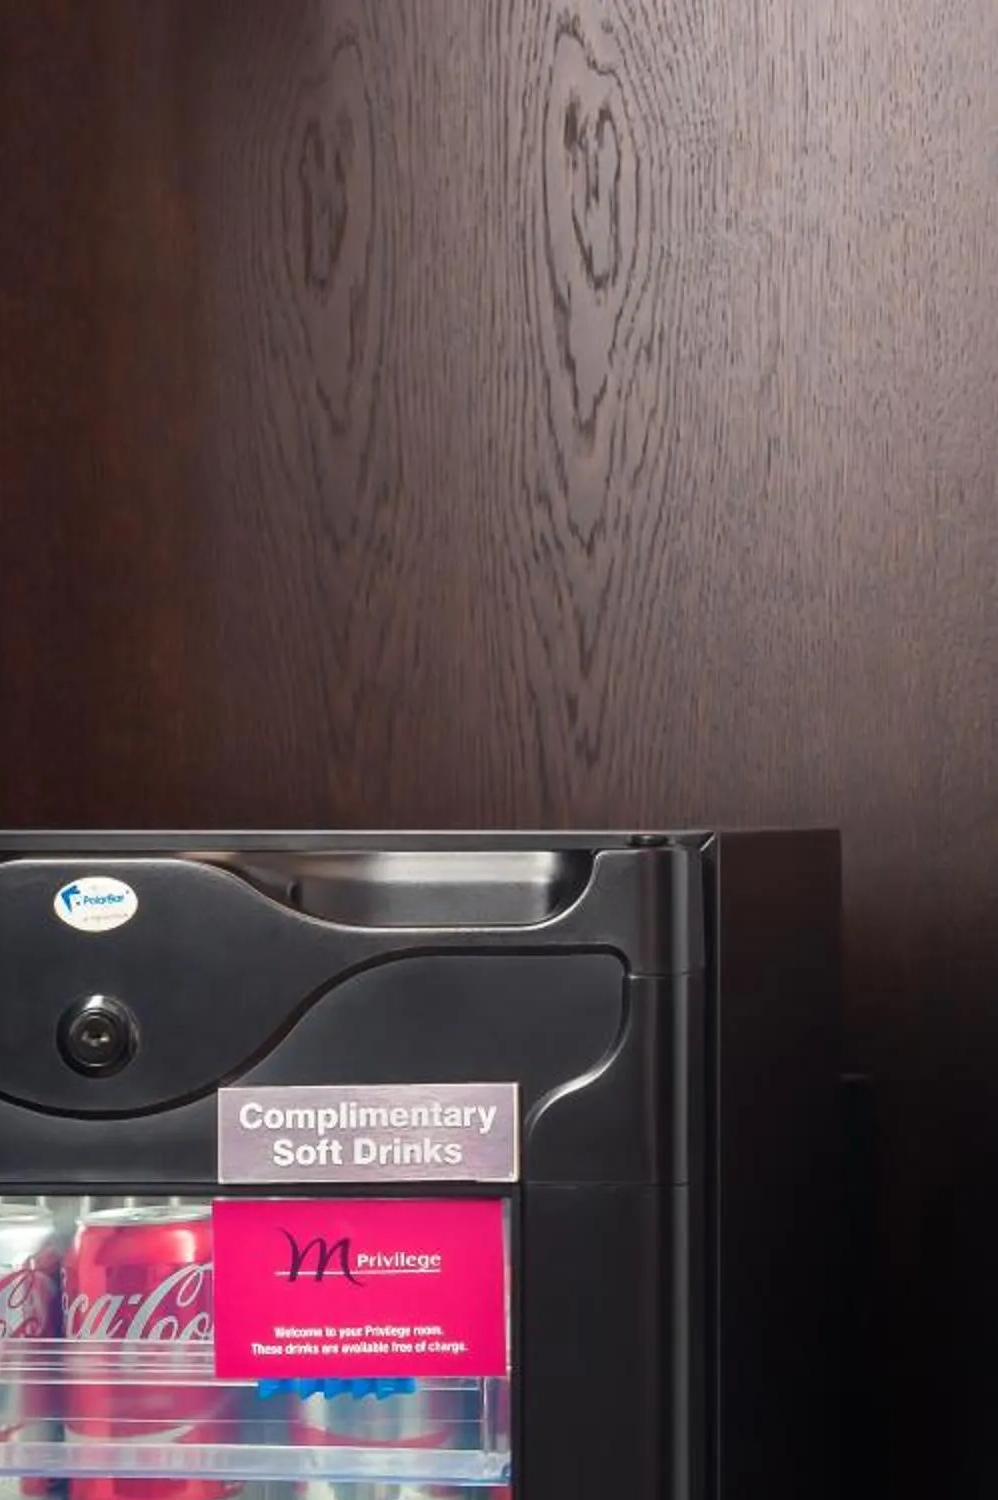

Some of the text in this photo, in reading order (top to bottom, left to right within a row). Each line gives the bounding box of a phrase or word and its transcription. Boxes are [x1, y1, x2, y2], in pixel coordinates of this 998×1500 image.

[239, 1102, 497, 1135] Complimentary
[273, 1138, 463, 1166] Soft Drinks
[357, 1252, 441, 1269] Privilege
[274, 1327, 323, 1338] Welcome
[325, 1327, 337, 1337] to
[339, 1327, 363, 1338] your
[365, 1325, 411, 1338] Privilege
[251, 1343, 283, 1355] These
[285, 1343, 319, 1355] drinks
[321, 1345, 339, 1354] are
[341, 1342, 389, 1354] available
[390, 1341, 413, 1353] free
[414, 1341, 427, 1353] of
